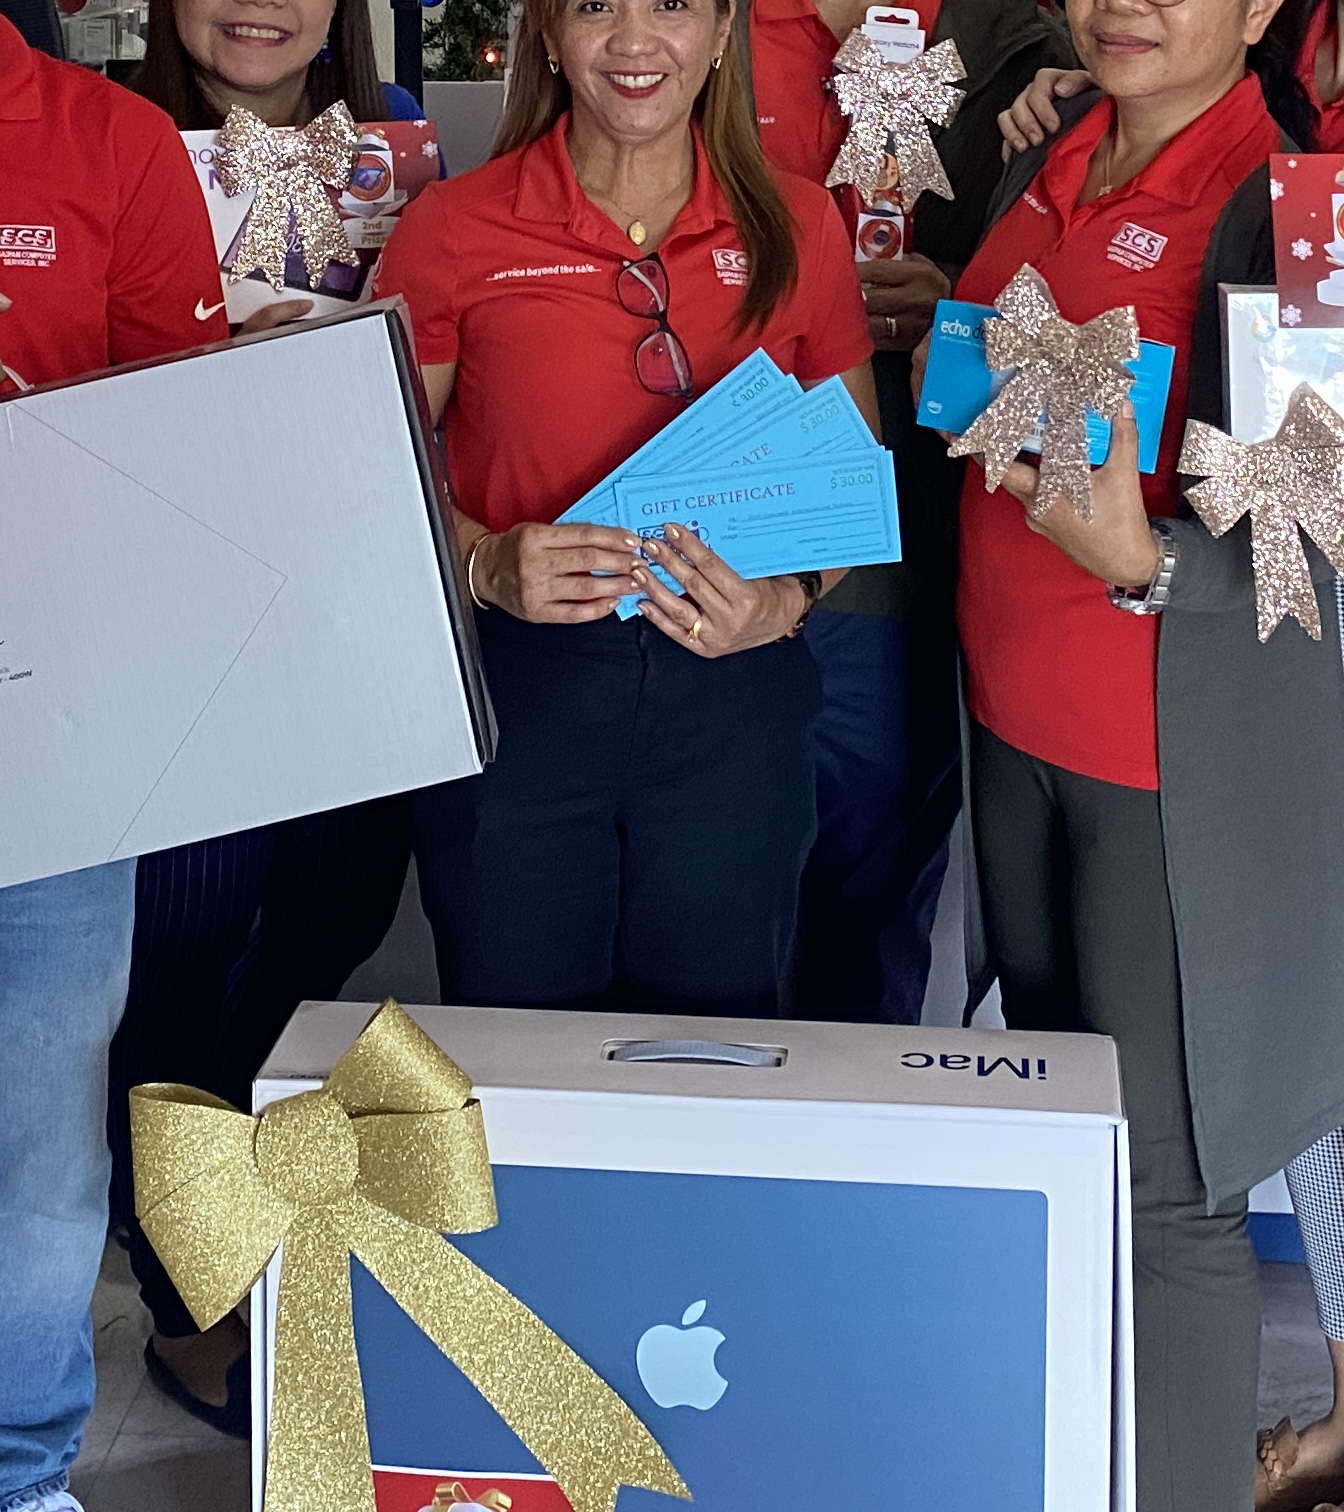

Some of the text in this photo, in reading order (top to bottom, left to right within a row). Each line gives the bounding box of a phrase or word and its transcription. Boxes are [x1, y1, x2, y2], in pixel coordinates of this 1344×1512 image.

[362, 221, 383, 230] 2nd
[1, 229, 48, 247] SCS
[1119, 228, 1158, 253] SCS
[940, 319, 971, 338] echo
[840, 473, 873, 487] 30.00
[642, 498, 681, 516] GIFT
[685, 482, 795, 510] CERTIFICATE
[901, 1052, 1047, 1080] iMac
